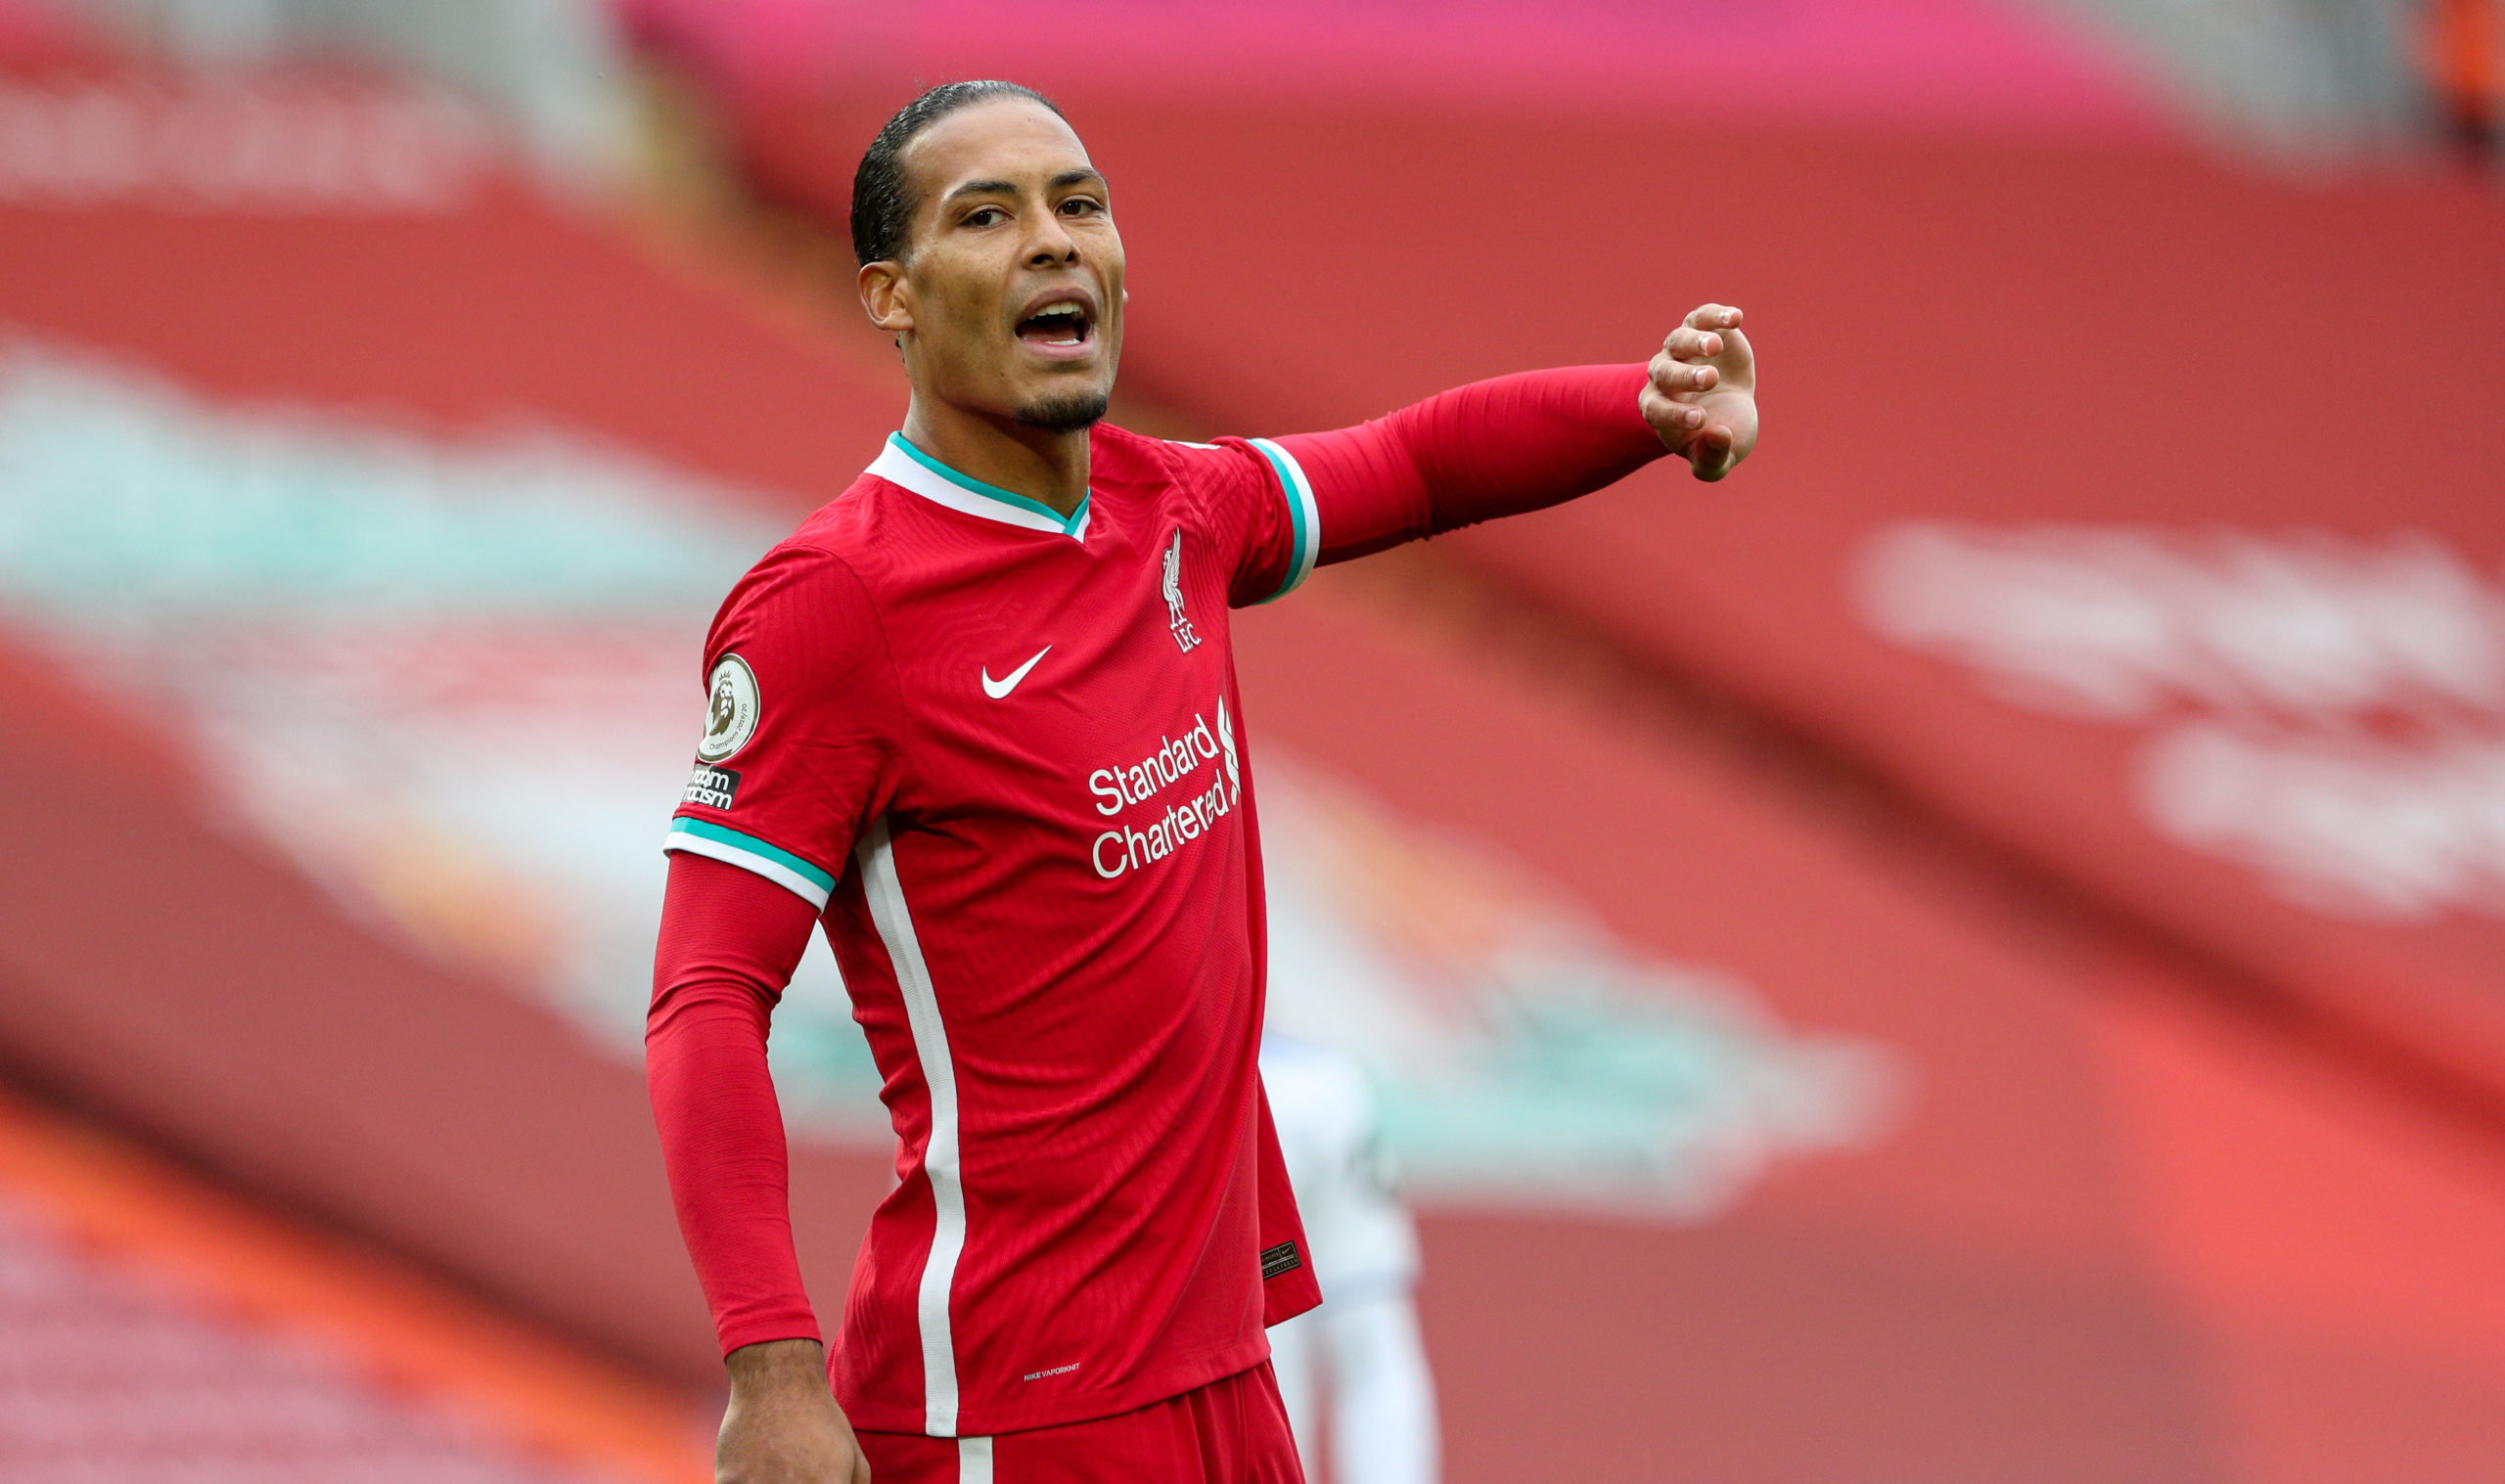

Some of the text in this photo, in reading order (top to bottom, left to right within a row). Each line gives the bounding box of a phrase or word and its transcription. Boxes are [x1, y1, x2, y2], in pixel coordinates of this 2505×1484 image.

[736, 703, 748, 731] 2019/20
[1088, 712, 1220, 816] Standard
[1092, 768, 1230, 878] Chartered
[1024, 1362, 1081, 1381] NIKE VAPORKNIT
